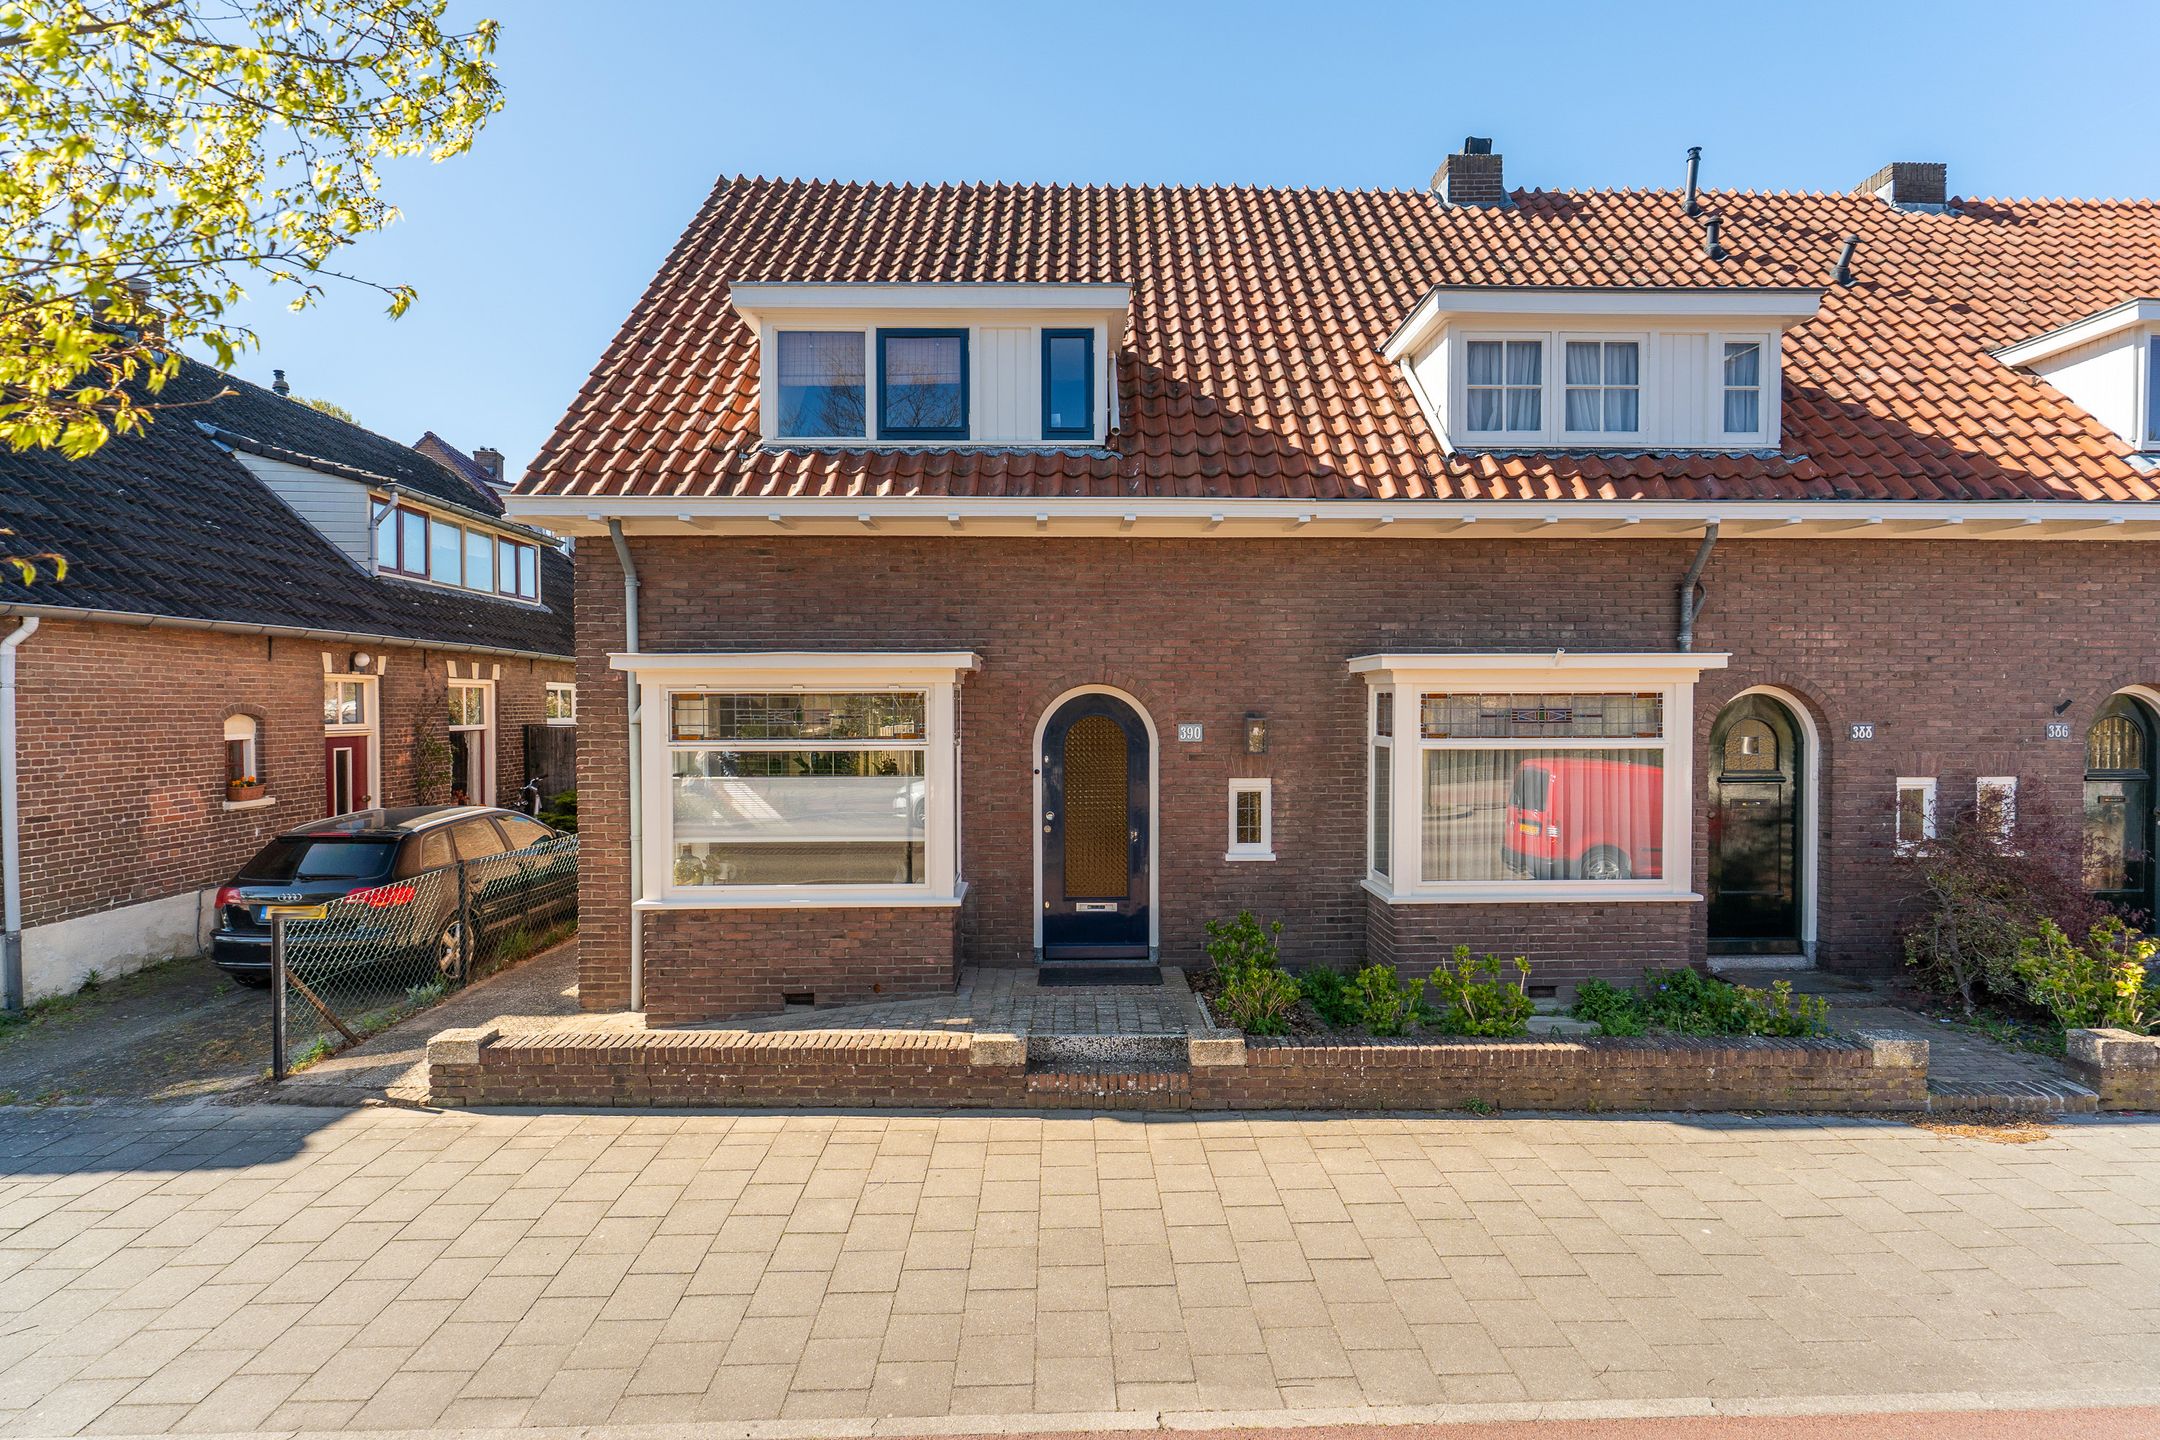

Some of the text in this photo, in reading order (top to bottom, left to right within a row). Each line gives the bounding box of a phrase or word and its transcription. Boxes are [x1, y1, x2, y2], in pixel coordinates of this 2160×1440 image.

[1180, 726, 1201, 739] 390
[1852, 725, 1872, 738] 388
[2048, 725, 2068, 738] 386
